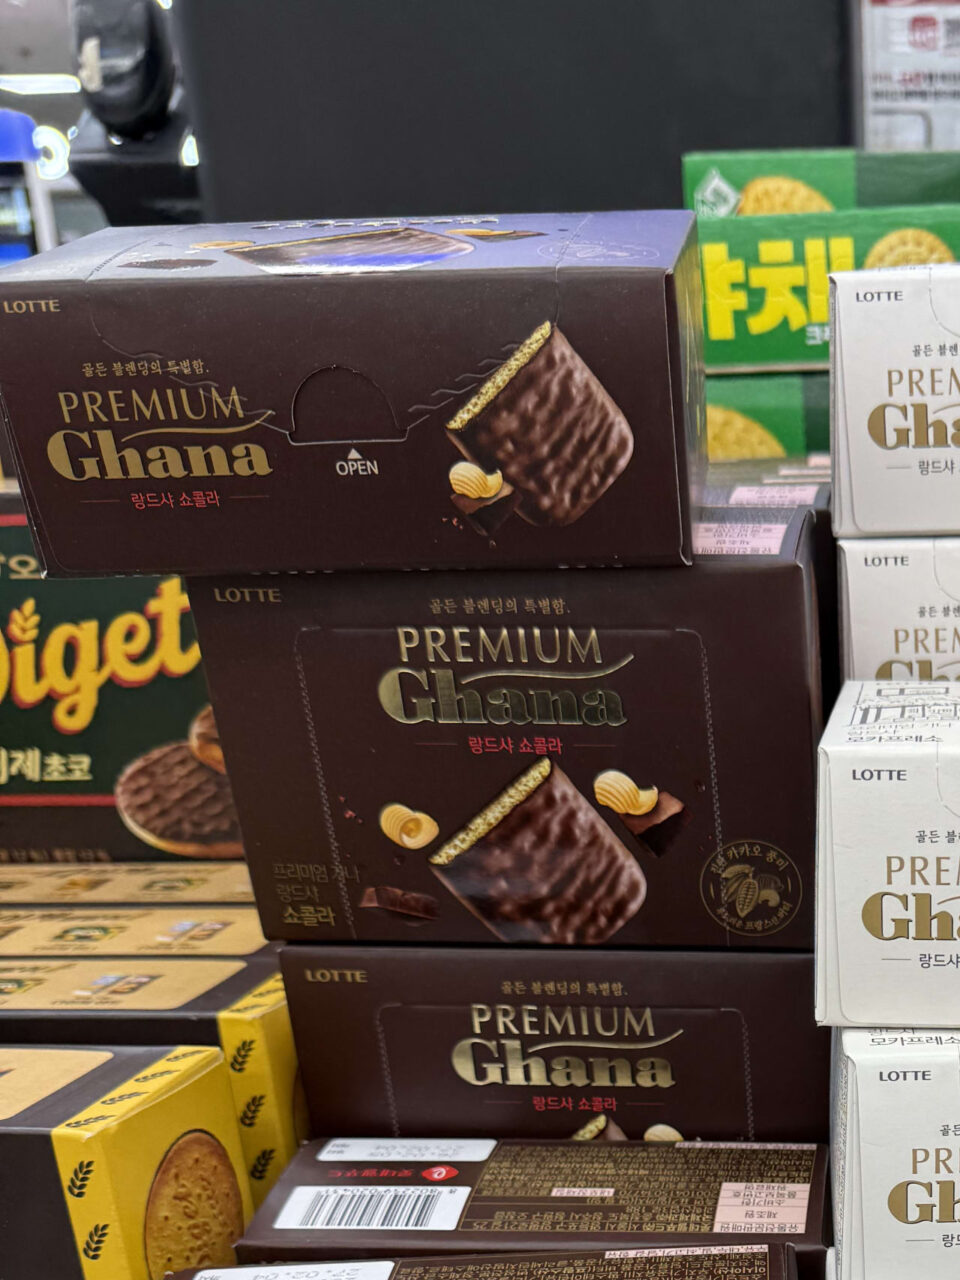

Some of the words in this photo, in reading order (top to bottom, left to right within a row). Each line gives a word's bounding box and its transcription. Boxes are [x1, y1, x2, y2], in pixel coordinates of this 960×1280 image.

[856, 291, 903, 302] LOTTE
[4, 299, 61, 313] LOTTE
[82, 362, 107, 377] 골든
[58, 386, 245, 423] PREMIUM
[47, 428, 273, 481] Ghana
[335, 460, 379, 476] OPEN
[864, 556, 909, 567] LOTTE
[214, 588, 282, 603] LOTTE
[398, 626, 605, 664] PREMIUM
[378, 667, 627, 726] Ghana
[852, 769, 907, 781] LOTTE
[918, 952, 960, 968] 랑드샤
[471, 1004, 656, 1037] PREMIUM
[451, 1037, 675, 1088] Ghana
[879, 1070, 931, 1082] LOTTE
